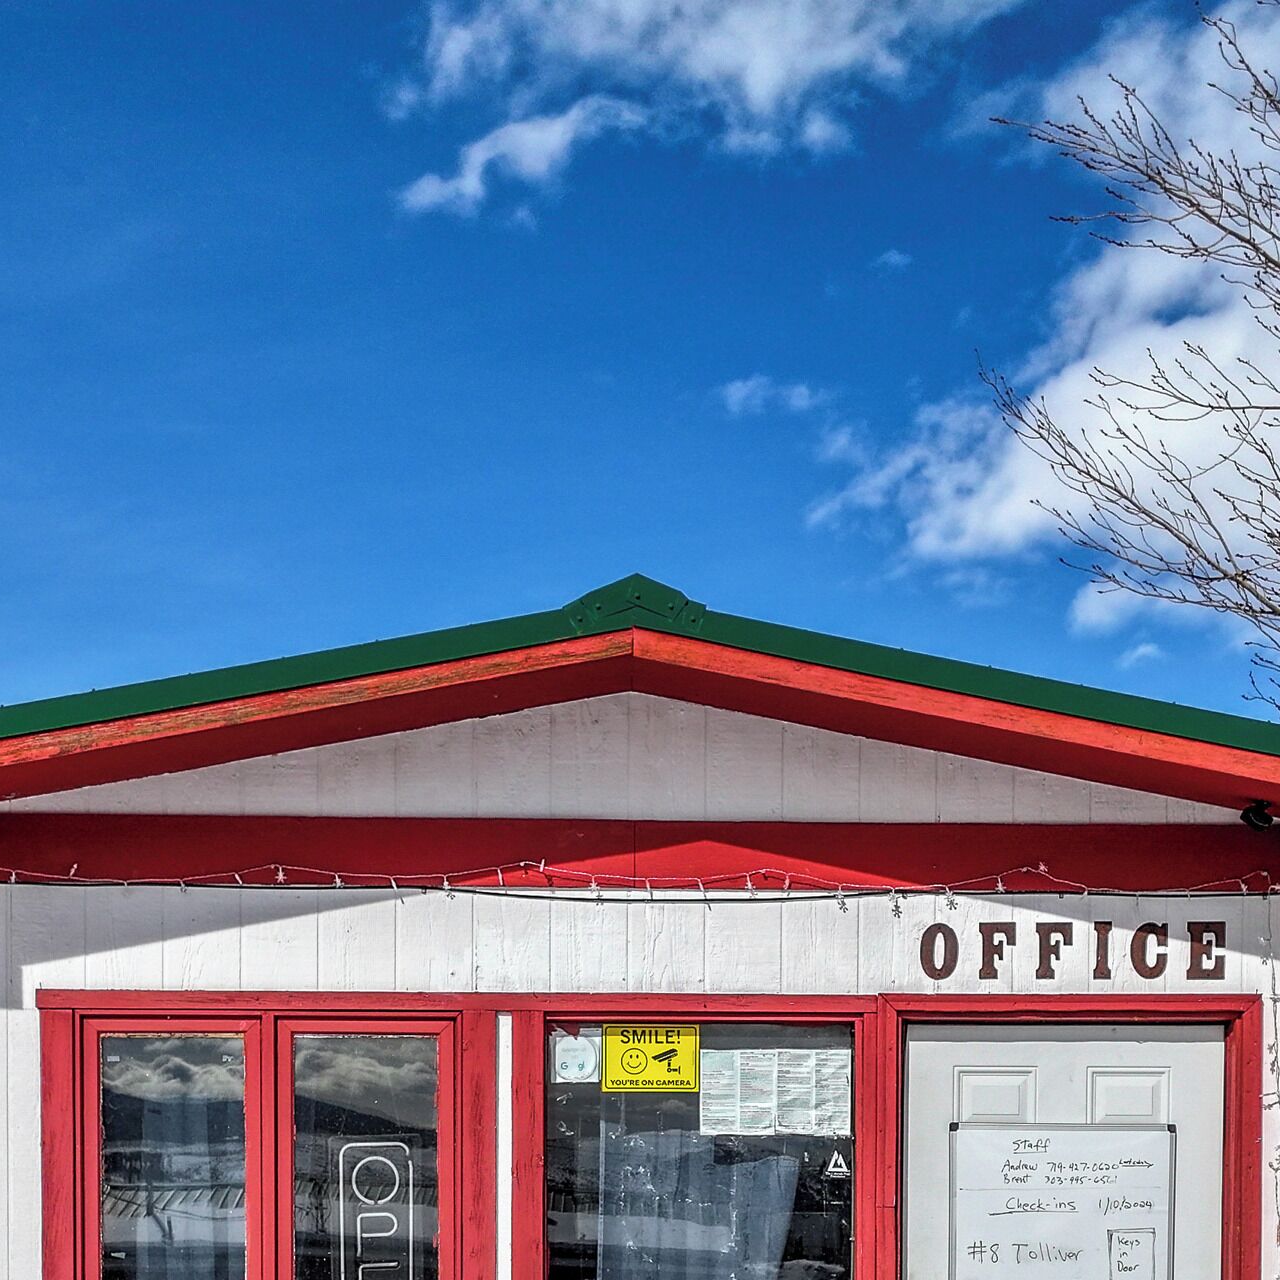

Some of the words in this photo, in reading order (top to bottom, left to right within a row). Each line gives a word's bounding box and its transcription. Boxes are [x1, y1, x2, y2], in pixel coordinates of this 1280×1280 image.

[920, 921, 1226, 979] OFFICE
[620, 1029, 681, 1044] SMILE!
[610, 1079, 640, 1087] YOU'RE
[641, 1079, 654, 1087] ON
[655, 1079, 692, 1087] CAMERA
[1012, 1137, 1051, 1152] Staff
[1001, 1159, 1038, 1172] Andrew
[1117, 1235, 1141, 1249] Keys
[967, 1241, 1000, 1264] #8
[1012, 1242, 1084, 1264] Tolliver
[1118, 1248, 1129, 1258] in
[1117, 1261, 1140, 1273] Door
